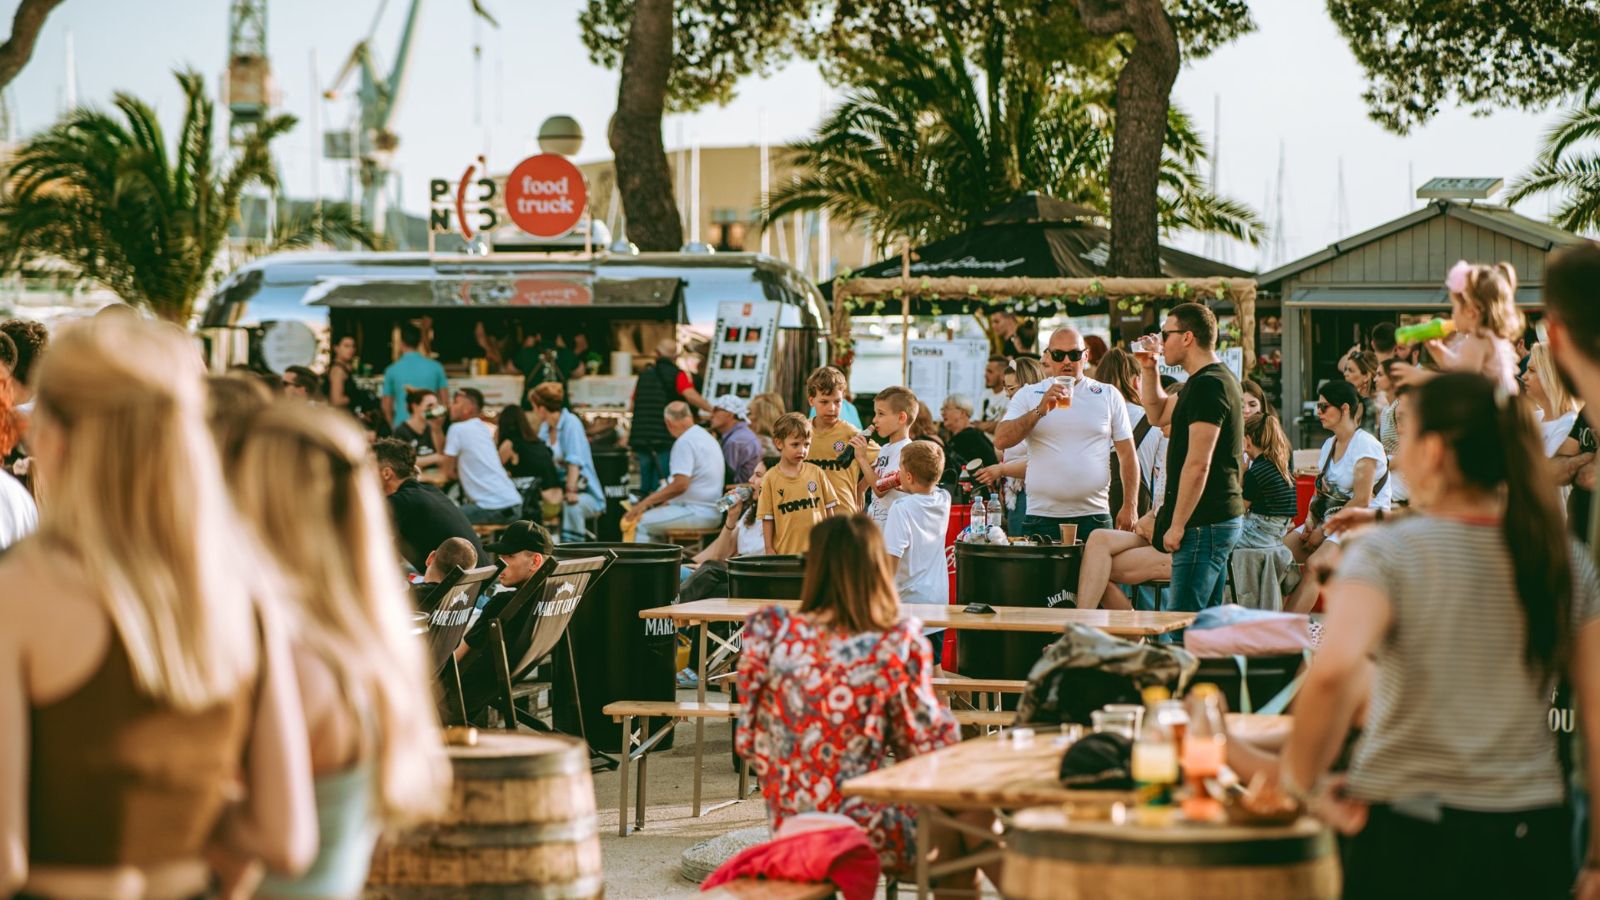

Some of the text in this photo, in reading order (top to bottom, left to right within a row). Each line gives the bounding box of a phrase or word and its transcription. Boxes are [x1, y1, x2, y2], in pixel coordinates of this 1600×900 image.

[522, 175, 569, 195] food
[517, 196, 574, 214] truck
[777, 496, 820, 515] TOMMY
